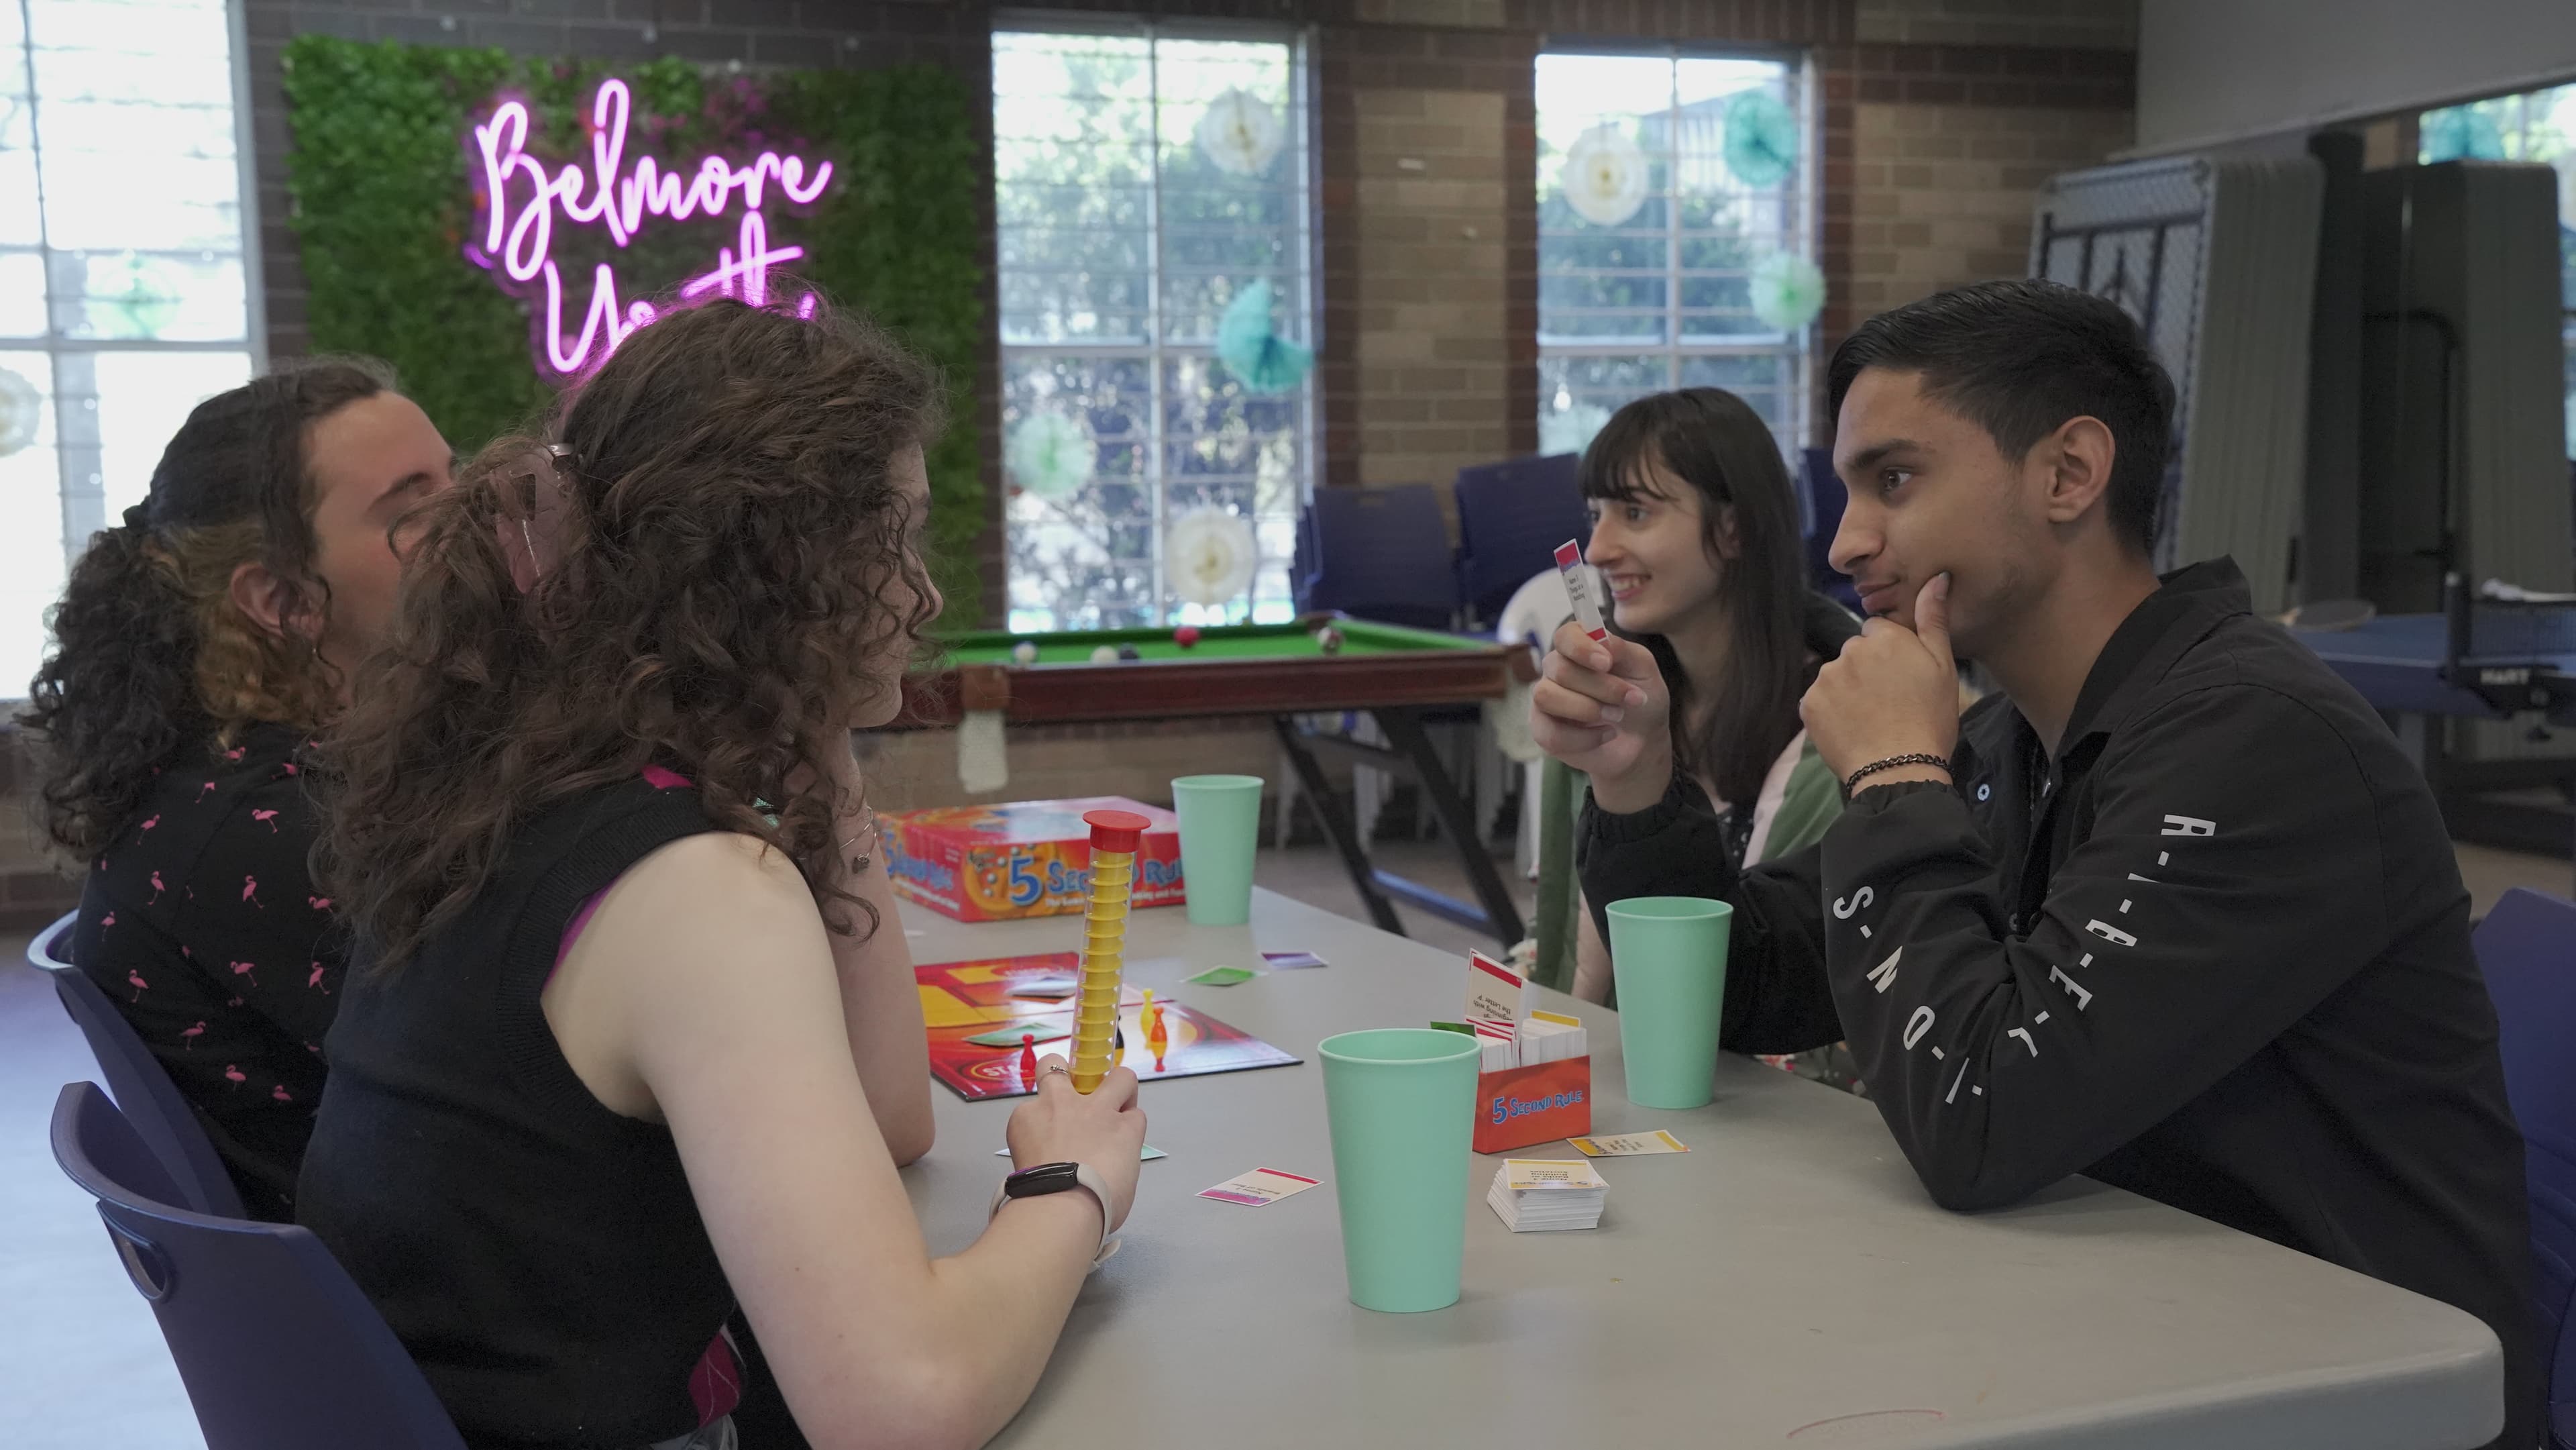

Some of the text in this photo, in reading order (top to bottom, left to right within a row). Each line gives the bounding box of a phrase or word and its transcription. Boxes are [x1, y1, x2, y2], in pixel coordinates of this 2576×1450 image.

[475, 78, 834, 282] Belmore
[1009, 856, 1044, 907] 5
[1473, 1000, 1485, 1009] with
[1485, 997, 1501, 1010] Letter
[1502, 1006, 1511, 1015] the
[1493, 1090, 1582, 1125] 5 SECOND RULE
